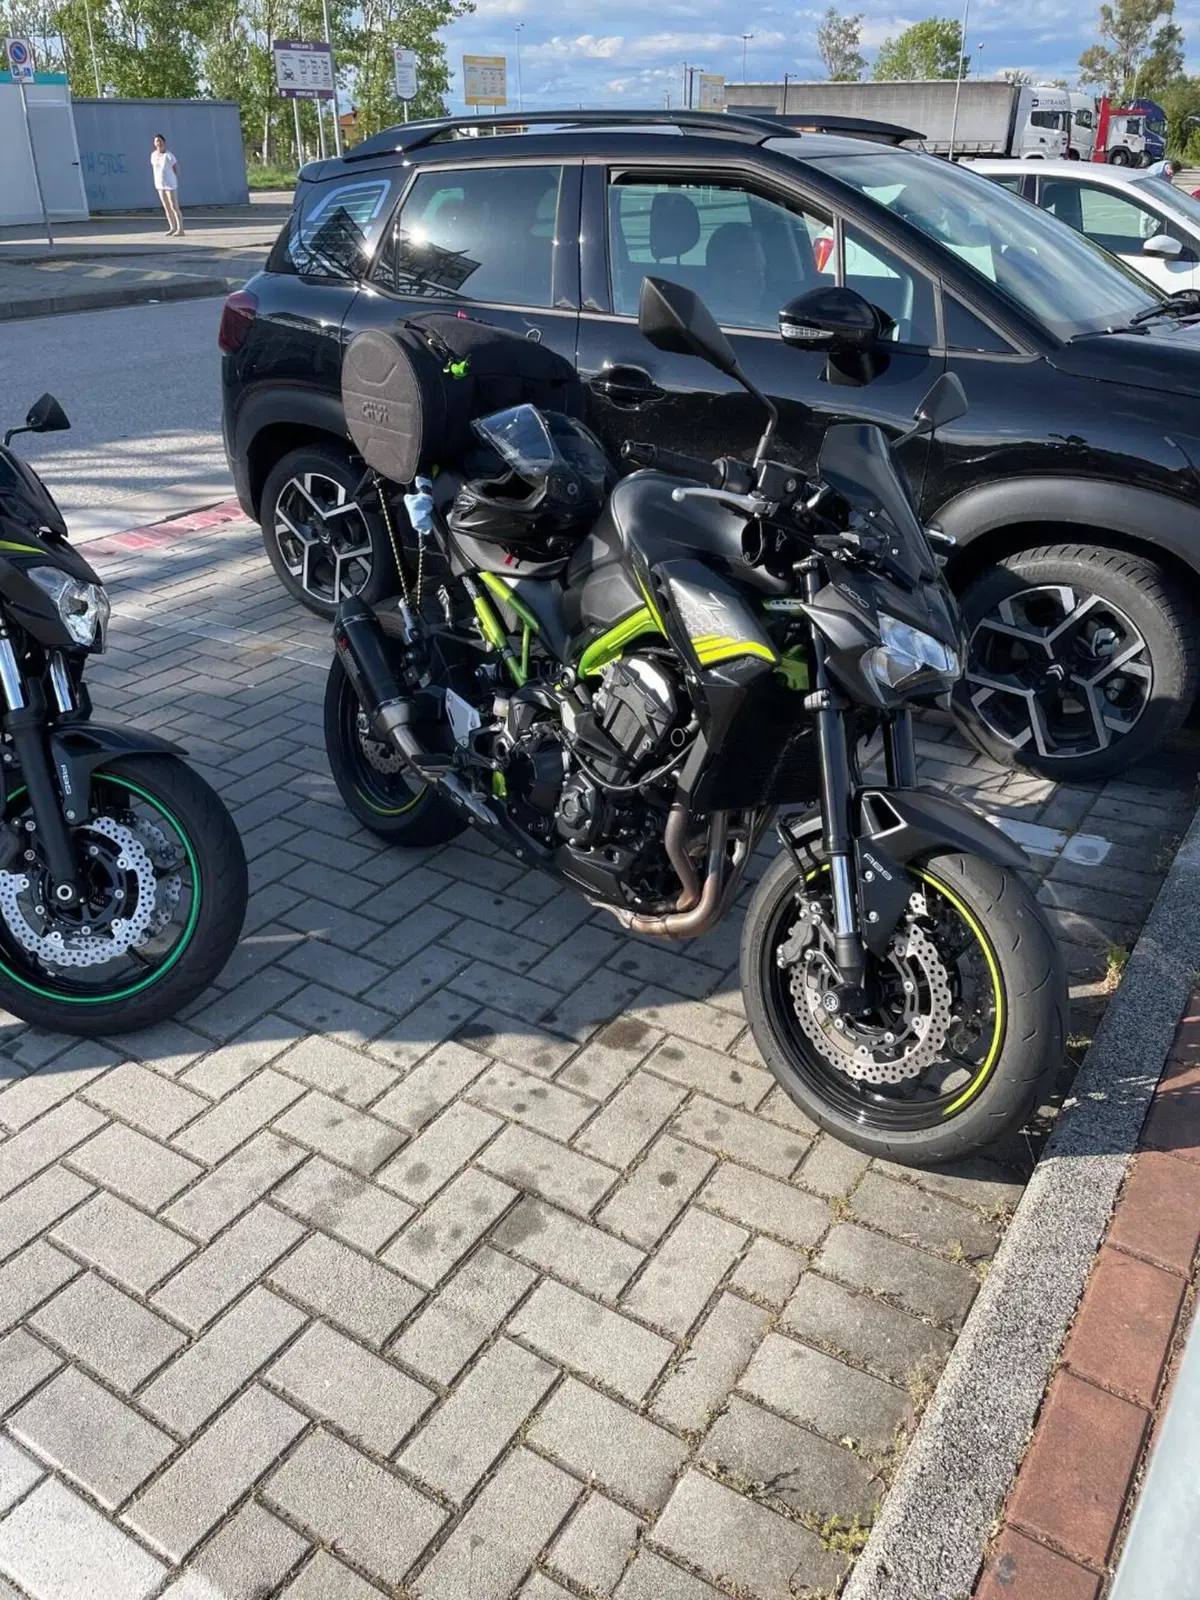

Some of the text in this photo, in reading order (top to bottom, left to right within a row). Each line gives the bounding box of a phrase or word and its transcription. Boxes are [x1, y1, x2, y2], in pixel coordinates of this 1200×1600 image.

[838, 583, 870, 609] 900
[60, 764, 72, 795] ABS
[862, 852, 893, 881] ABS
